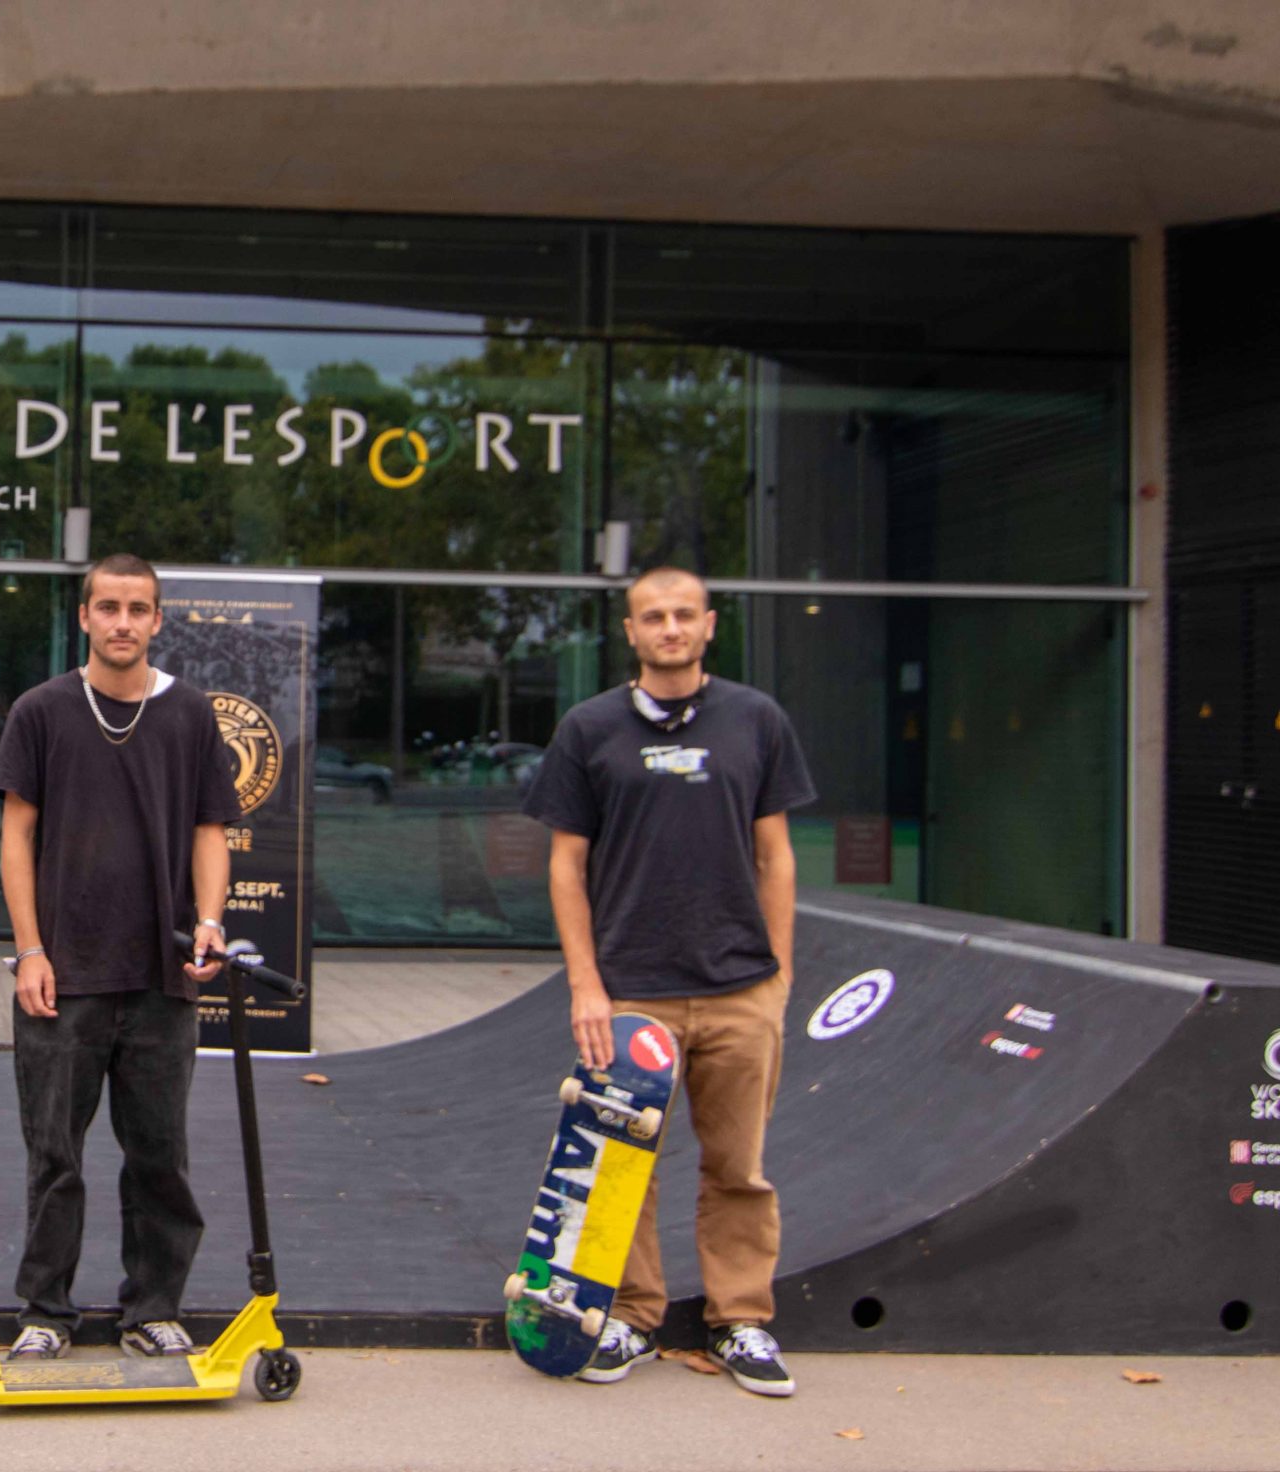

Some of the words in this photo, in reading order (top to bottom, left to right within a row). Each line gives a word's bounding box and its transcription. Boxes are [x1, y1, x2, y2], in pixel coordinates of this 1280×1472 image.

[16, 399, 121, 462] DE
[167, 404, 582, 488] L'ESPORT
[213, 697, 260, 726] OTER
[224, 827, 253, 838] RLD
[226, 838, 253, 851] ATE
[234, 881, 286, 899] SEPT.
